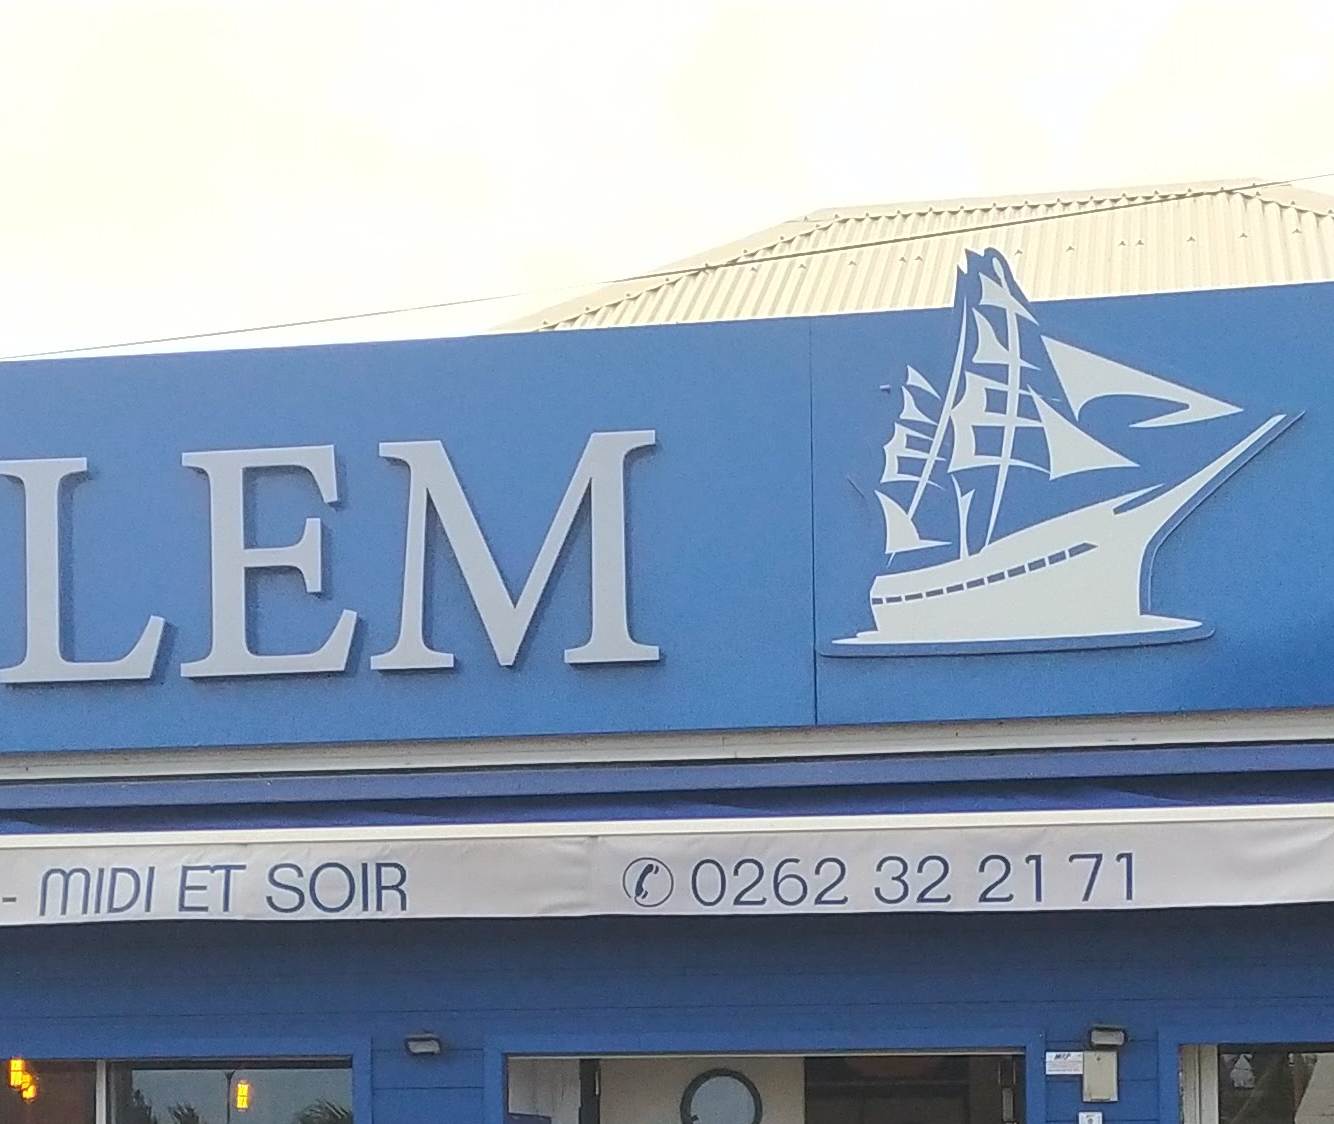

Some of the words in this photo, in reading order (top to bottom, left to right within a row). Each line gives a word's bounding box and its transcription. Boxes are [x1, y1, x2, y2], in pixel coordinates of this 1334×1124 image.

[38, 866, 156, 917] MIDI
[177, 863, 247, 913] ET
[265, 861, 409, 914] SOIR
[690, 857, 850, 907] 0262
[873, 855, 953, 905] 32
[977, 853, 1045, 903] 21
[1067, 851, 1135, 903] 71
